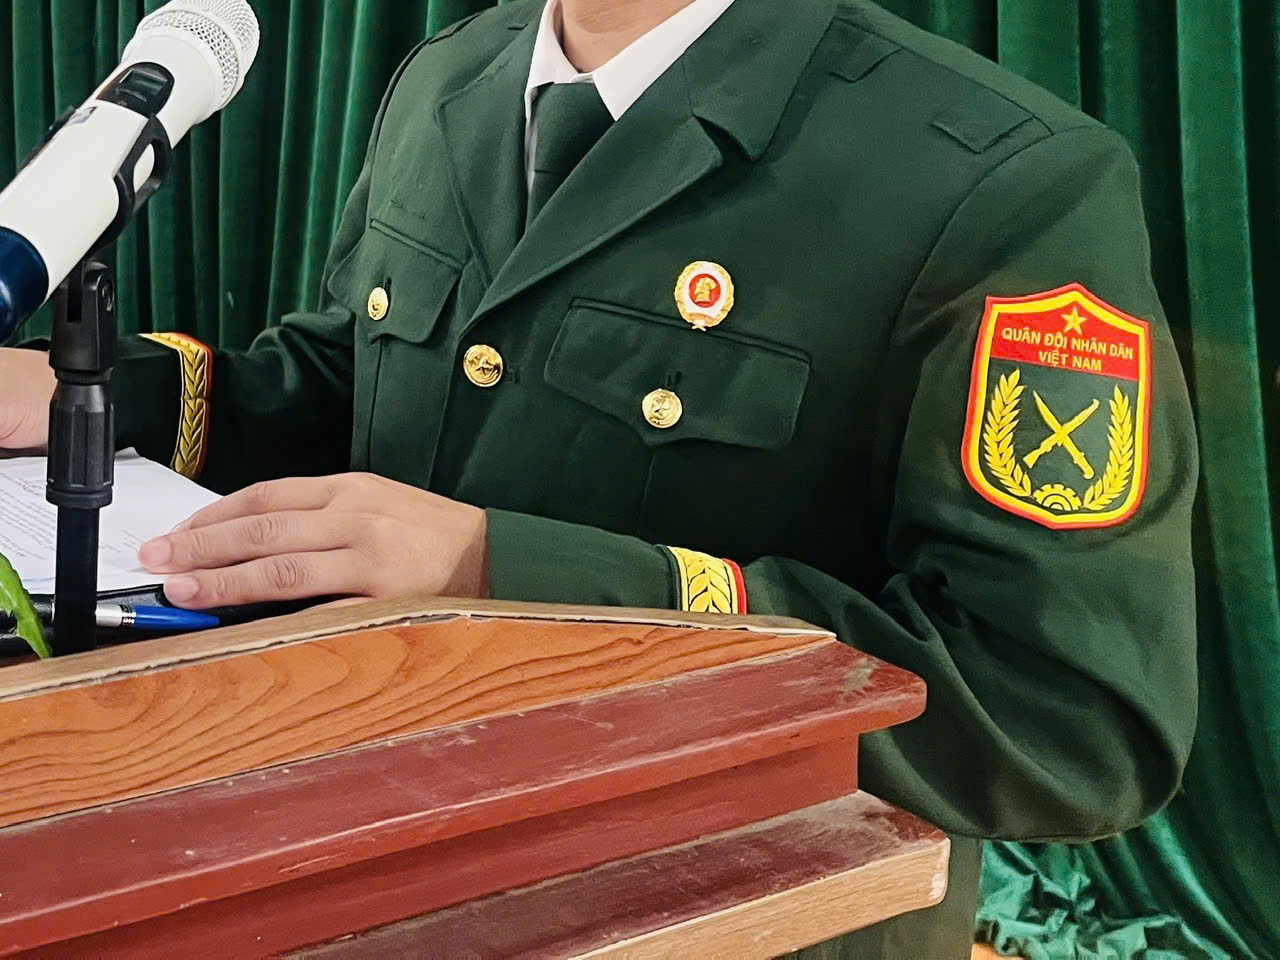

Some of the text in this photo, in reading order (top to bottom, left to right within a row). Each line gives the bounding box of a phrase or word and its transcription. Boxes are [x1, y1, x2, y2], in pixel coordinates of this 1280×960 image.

[1001, 326, 1133, 360] QUÂN ĐỘI NHÂN DÂN
[1039, 350, 1102, 372] VIỆT NAM
